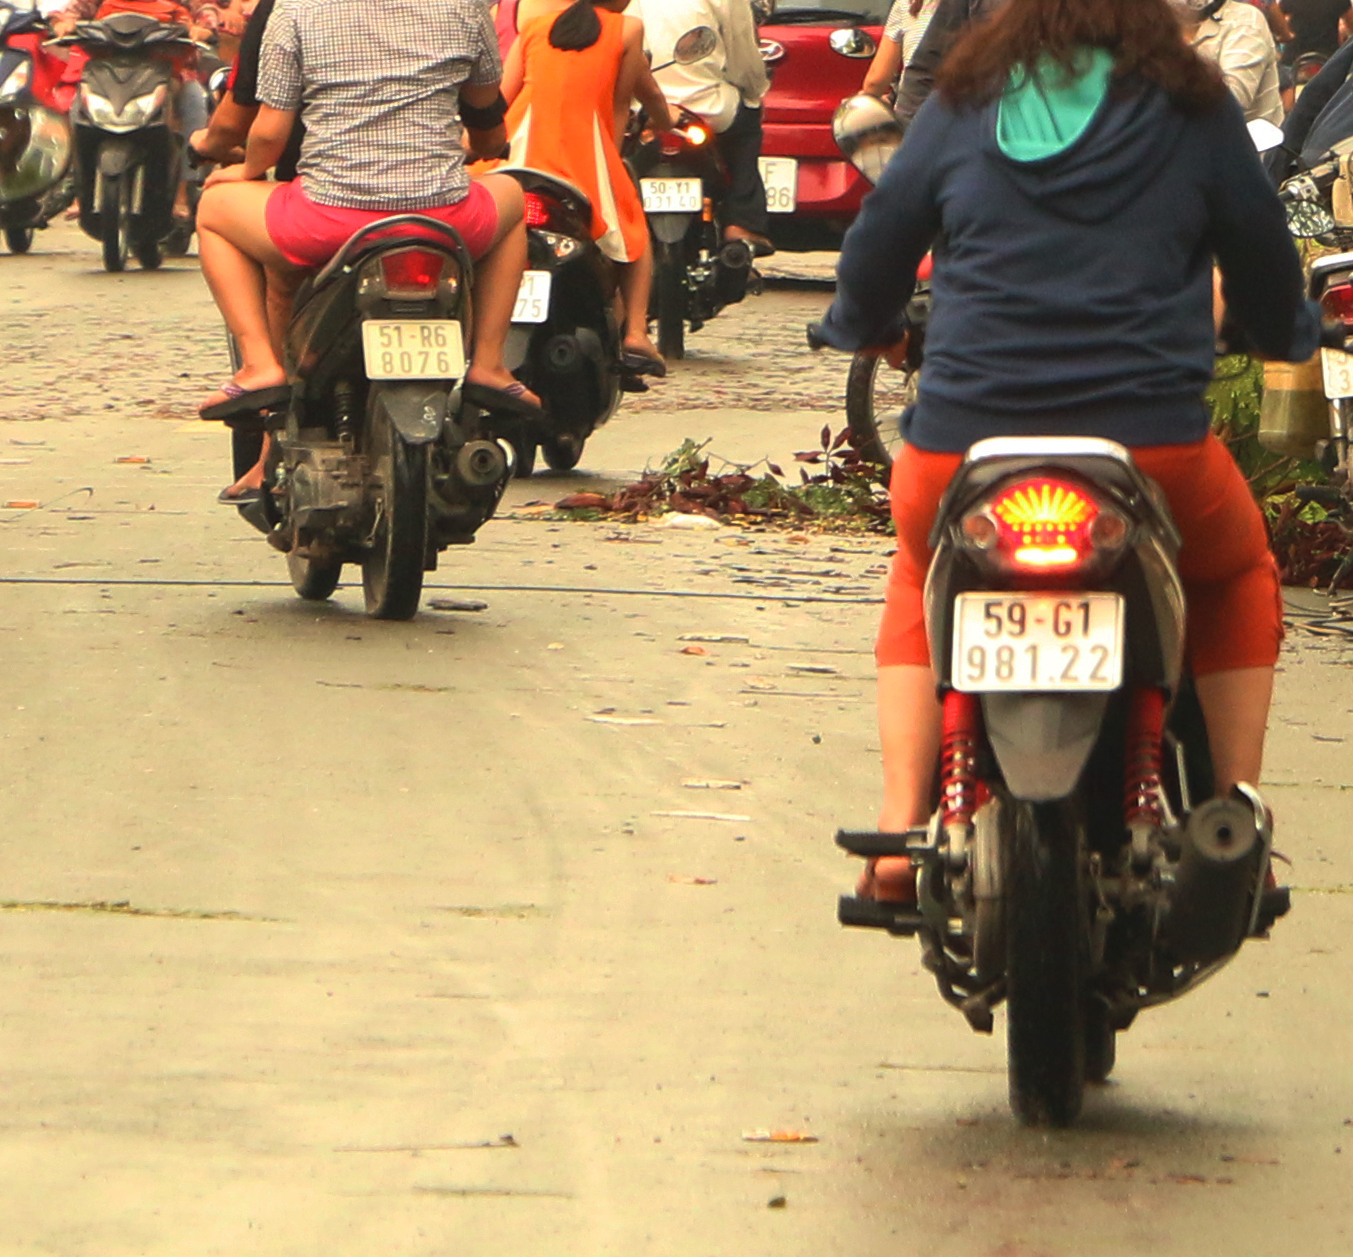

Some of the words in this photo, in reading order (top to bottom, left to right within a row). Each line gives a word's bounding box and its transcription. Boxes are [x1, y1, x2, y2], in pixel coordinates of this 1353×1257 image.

[379, 325, 447, 349] 51-R6
[381, 351, 450, 374] 8076
[983, 601, 1091, 638] 59-G1
[966, 644, 1110, 683] 981.22
